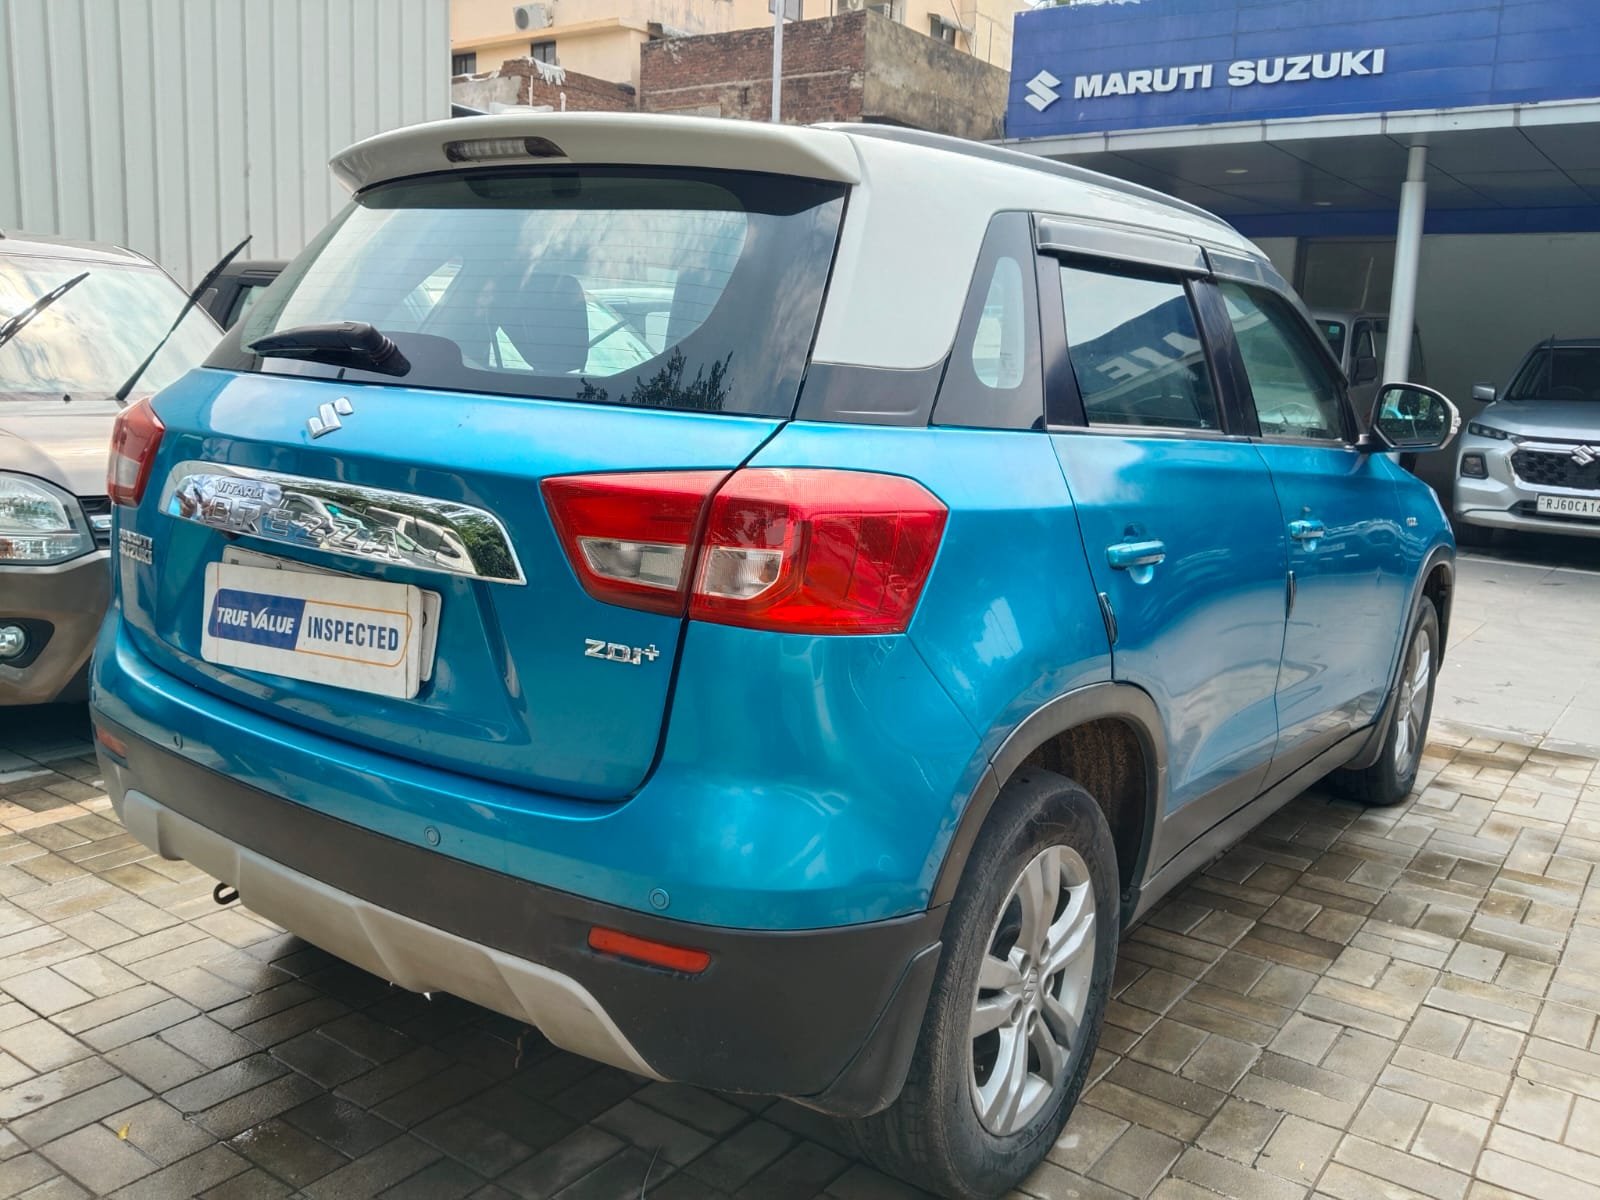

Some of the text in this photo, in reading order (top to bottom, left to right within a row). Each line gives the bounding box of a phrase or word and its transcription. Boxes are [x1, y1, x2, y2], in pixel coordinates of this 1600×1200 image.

[1074, 48, 1385, 99] MARUTI SUZUKI
[215, 479, 265, 500] VITARA
[205, 496, 402, 559] BREZZA
[119, 541, 153, 565] SUZUKI
[217, 606, 400, 652] TRUE VALUE INSPECTED
